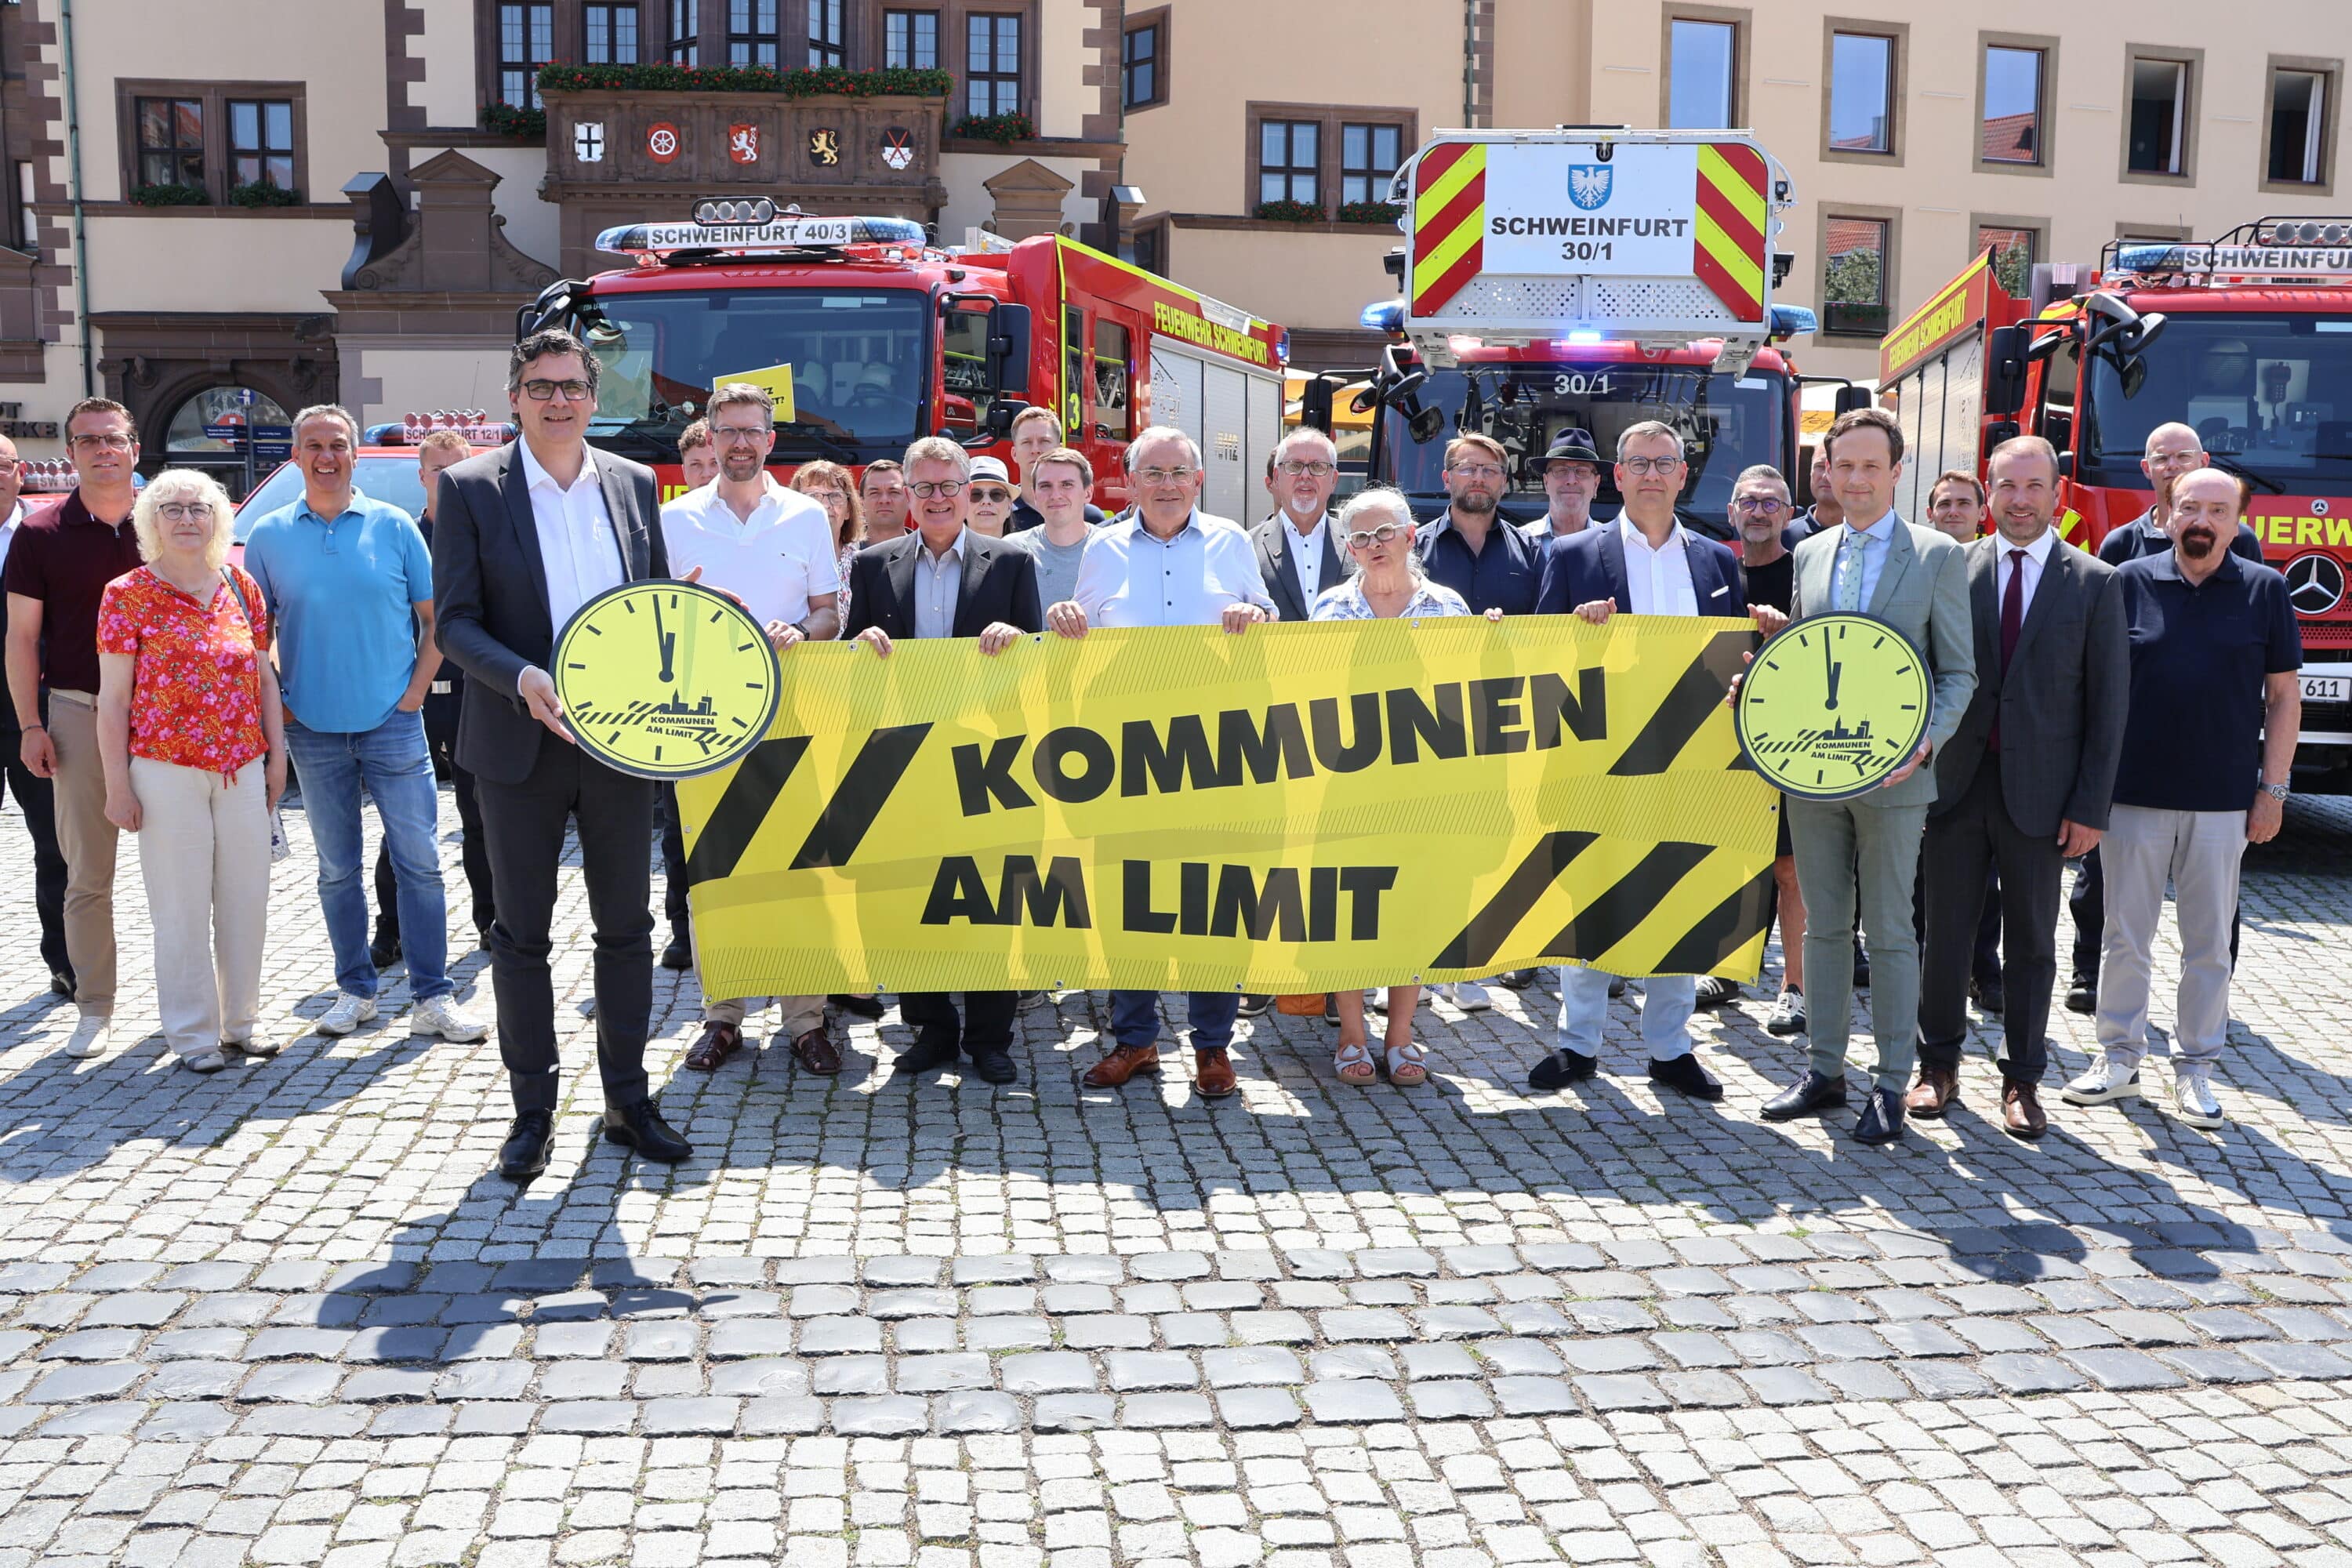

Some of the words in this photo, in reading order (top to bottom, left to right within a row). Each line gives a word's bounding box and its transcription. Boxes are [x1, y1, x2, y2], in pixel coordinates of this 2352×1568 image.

[652, 225, 798, 245] SCHWEINFURT
[804, 223, 847, 240] 40/3
[1491, 217, 1688, 237] SCHWEINFURT
[1561, 241, 1612, 260] 30/1
[1154, 301, 1212, 347] FEUERWEHR
[1214, 324, 1267, 365] SCHWEINFURT
[1554, 374, 1610, 394] 30/1
[1069, 393, 1080, 430] 3
[481, 429, 500, 440] 12/1
[39, 476, 58, 487] SW
[2305, 680, 2339, 697] 611
[651, 716, 714, 725] KOMMUNEN
[645, 726, 663, 735] AM
[666, 728, 694, 739] LIMIT
[951, 666, 1608, 817] KOMMUNEN
[1815, 741, 1871, 750] KOMMUNEN
[920, 855, 1092, 929] AM
[1123, 859, 1399, 942] LIMIT
